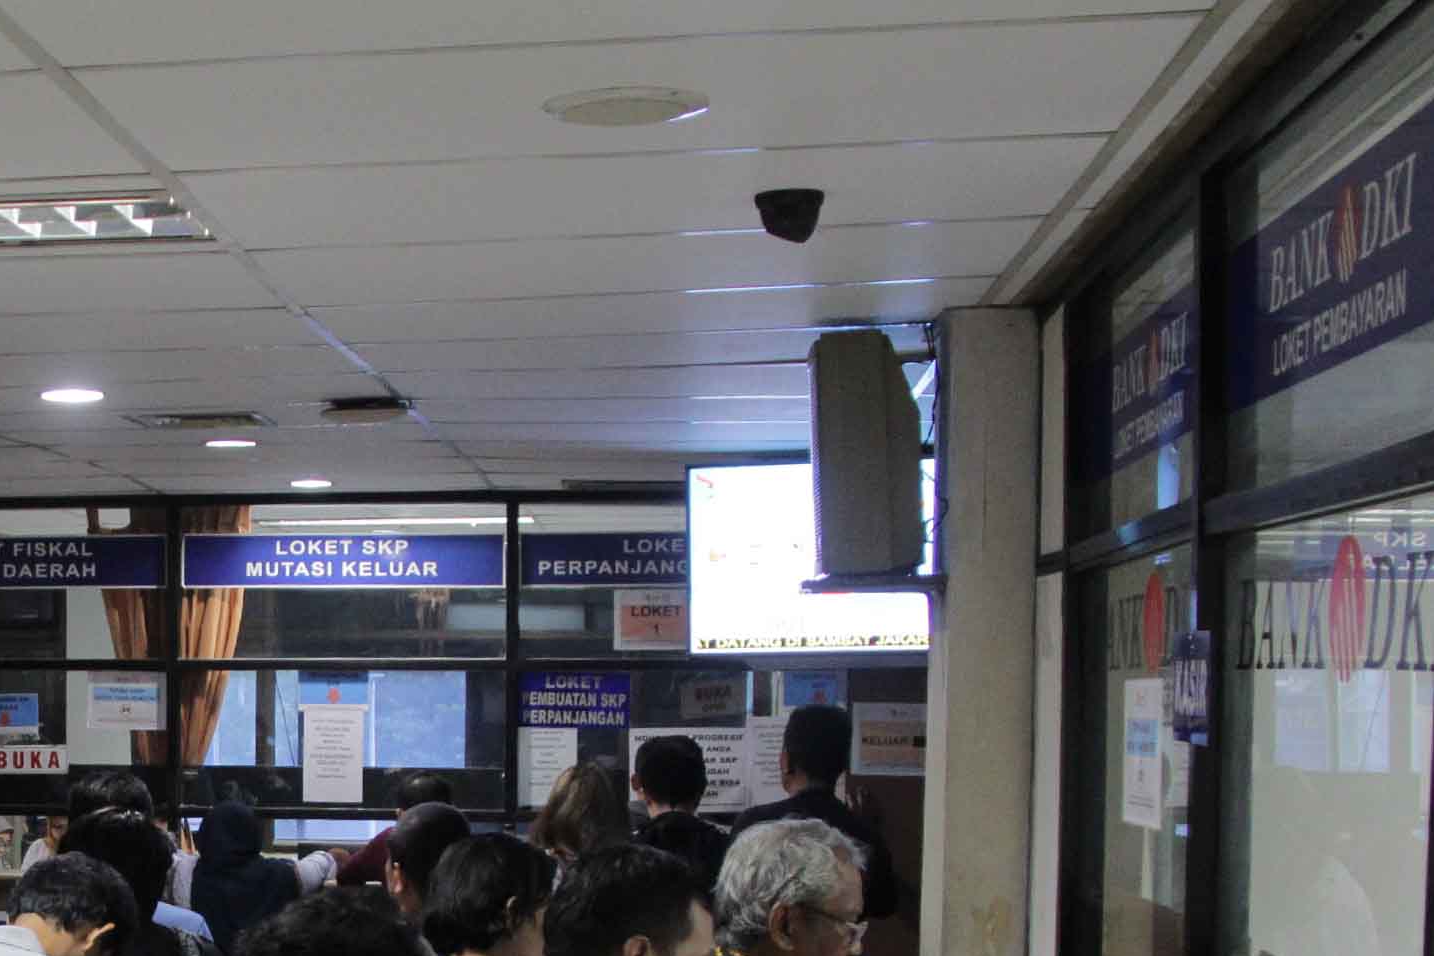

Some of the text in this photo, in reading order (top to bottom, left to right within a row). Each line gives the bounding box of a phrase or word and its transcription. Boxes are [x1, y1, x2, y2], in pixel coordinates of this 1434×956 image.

[1269, 152, 1416, 313] BANK DKI
[1272, 268, 1407, 377] LOKET PEMBAYARAN
[1112, 311, 1188, 415] BANK DKI
[13, 542, 94, 557] FISKAL
[275, 540, 409, 555] LOKET SKP
[3, 563, 97, 579] DAERAH
[246, 562, 439, 577] MUTASI KELUAR
[630, 605, 682, 617] LOKET
[546, 675, 603, 689] LOKET
[600, 693, 627, 708] SKP
